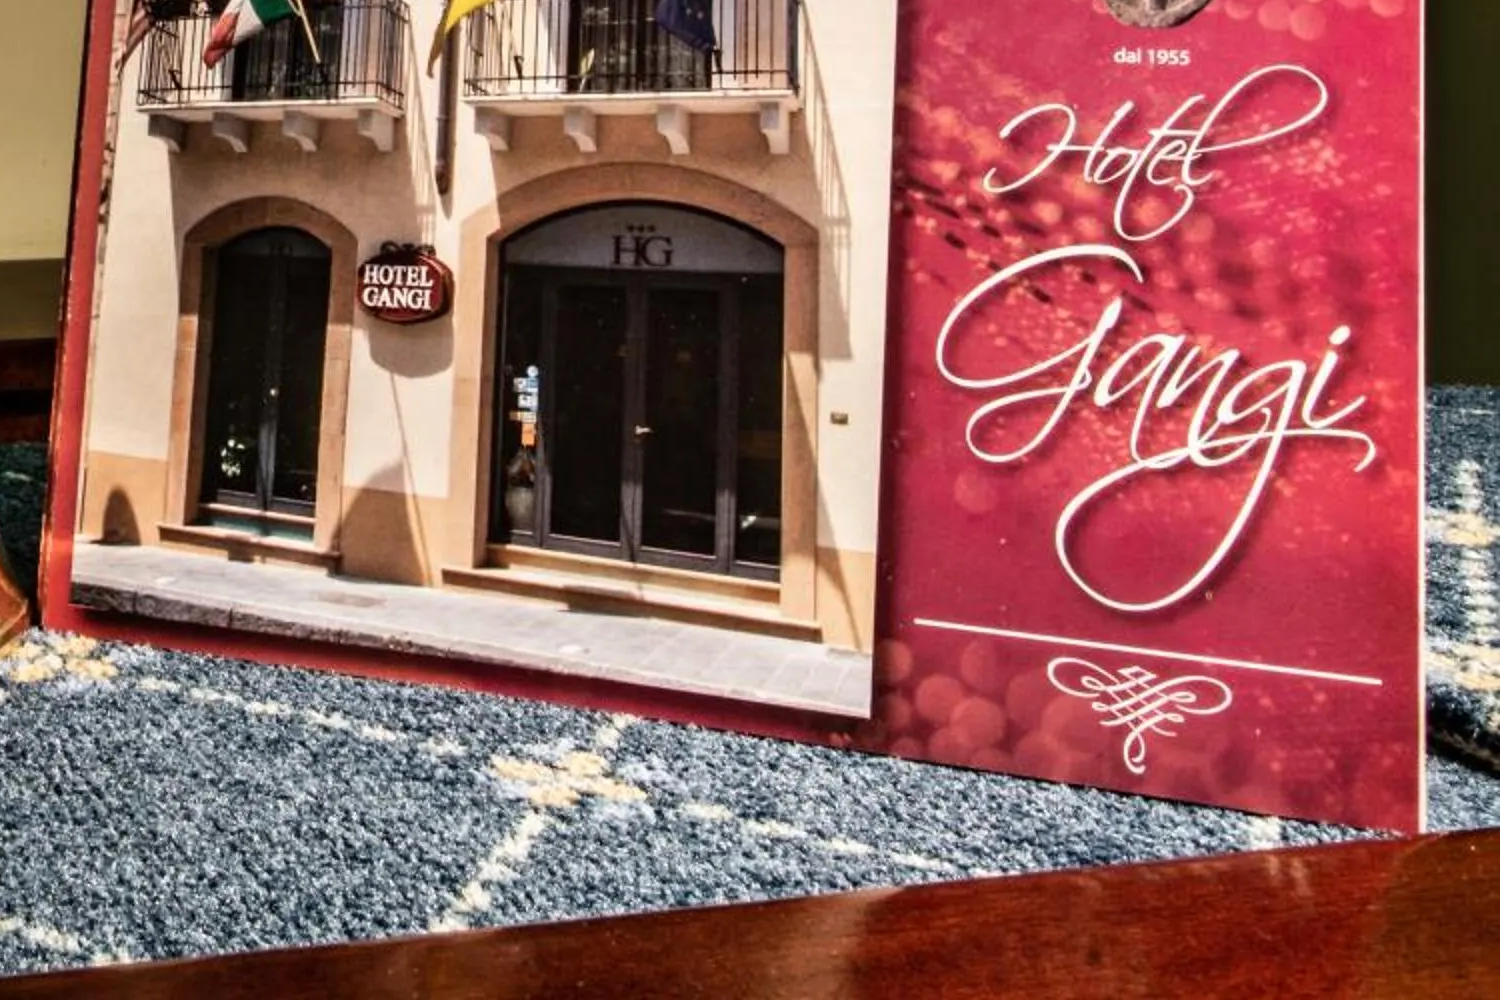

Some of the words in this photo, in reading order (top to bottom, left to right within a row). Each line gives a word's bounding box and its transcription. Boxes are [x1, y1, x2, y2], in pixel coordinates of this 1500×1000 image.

[1113, 46, 1142, 65] dal
[1147, 48, 1191, 66] 1955
[982, 64, 1329, 242] Hotel
[611, 234, 673, 268] HG
[363, 263, 434, 288] HOTEL
[362, 286, 433, 311] GANGI
[935, 243, 1377, 612] Gangi
